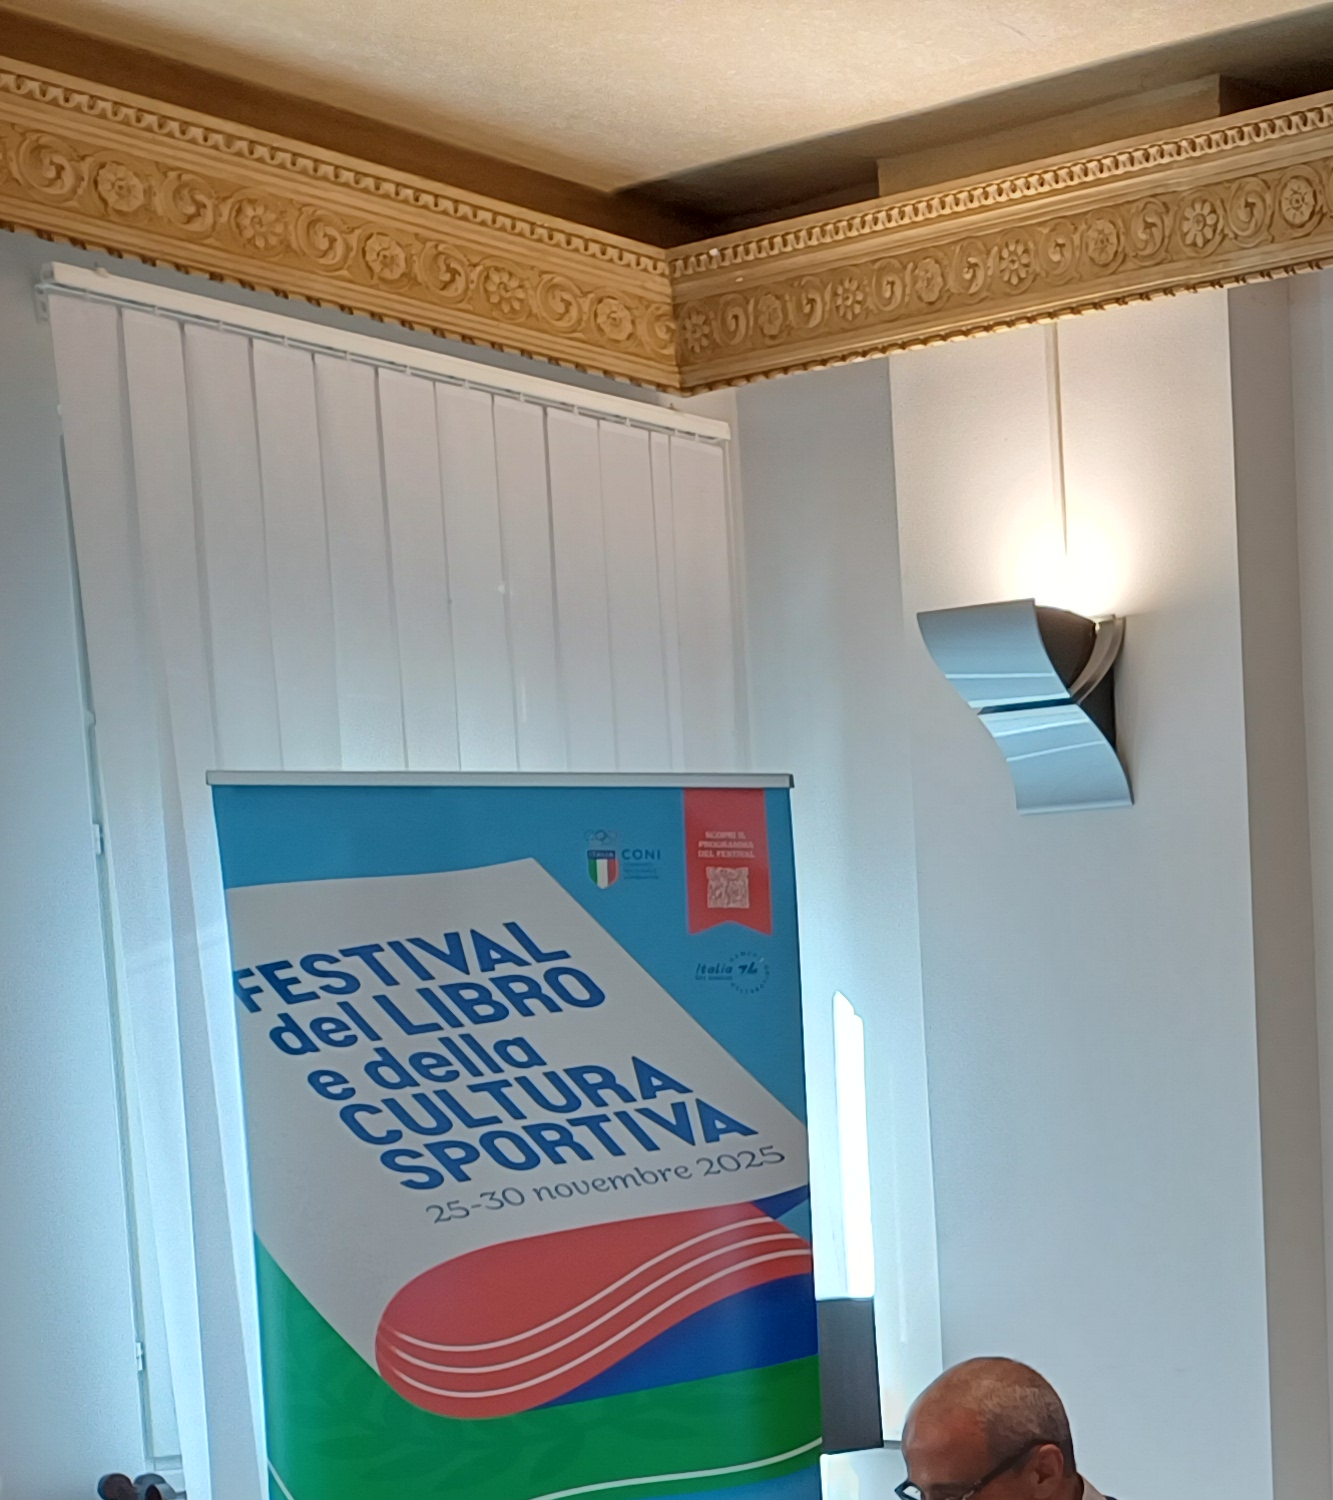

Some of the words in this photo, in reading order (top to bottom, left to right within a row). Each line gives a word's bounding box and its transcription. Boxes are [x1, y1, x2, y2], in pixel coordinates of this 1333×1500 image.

[621, 849, 661, 860] CONI
[234, 921, 571, 1013] FESTIVAL
[268, 1001, 381, 1056] del
[371, 965, 606, 1037] LIBRO
[306, 1069, 356, 1100] e
[363, 1035, 547, 1091] della
[339, 1055, 694, 1145] CULTURA
[380, 1097, 759, 1190] SPORTIVA
[426, 1186, 526, 1224] 25-30
[532, 1162, 693, 1203] novembre
[696, 1145, 785, 1177] 2025
